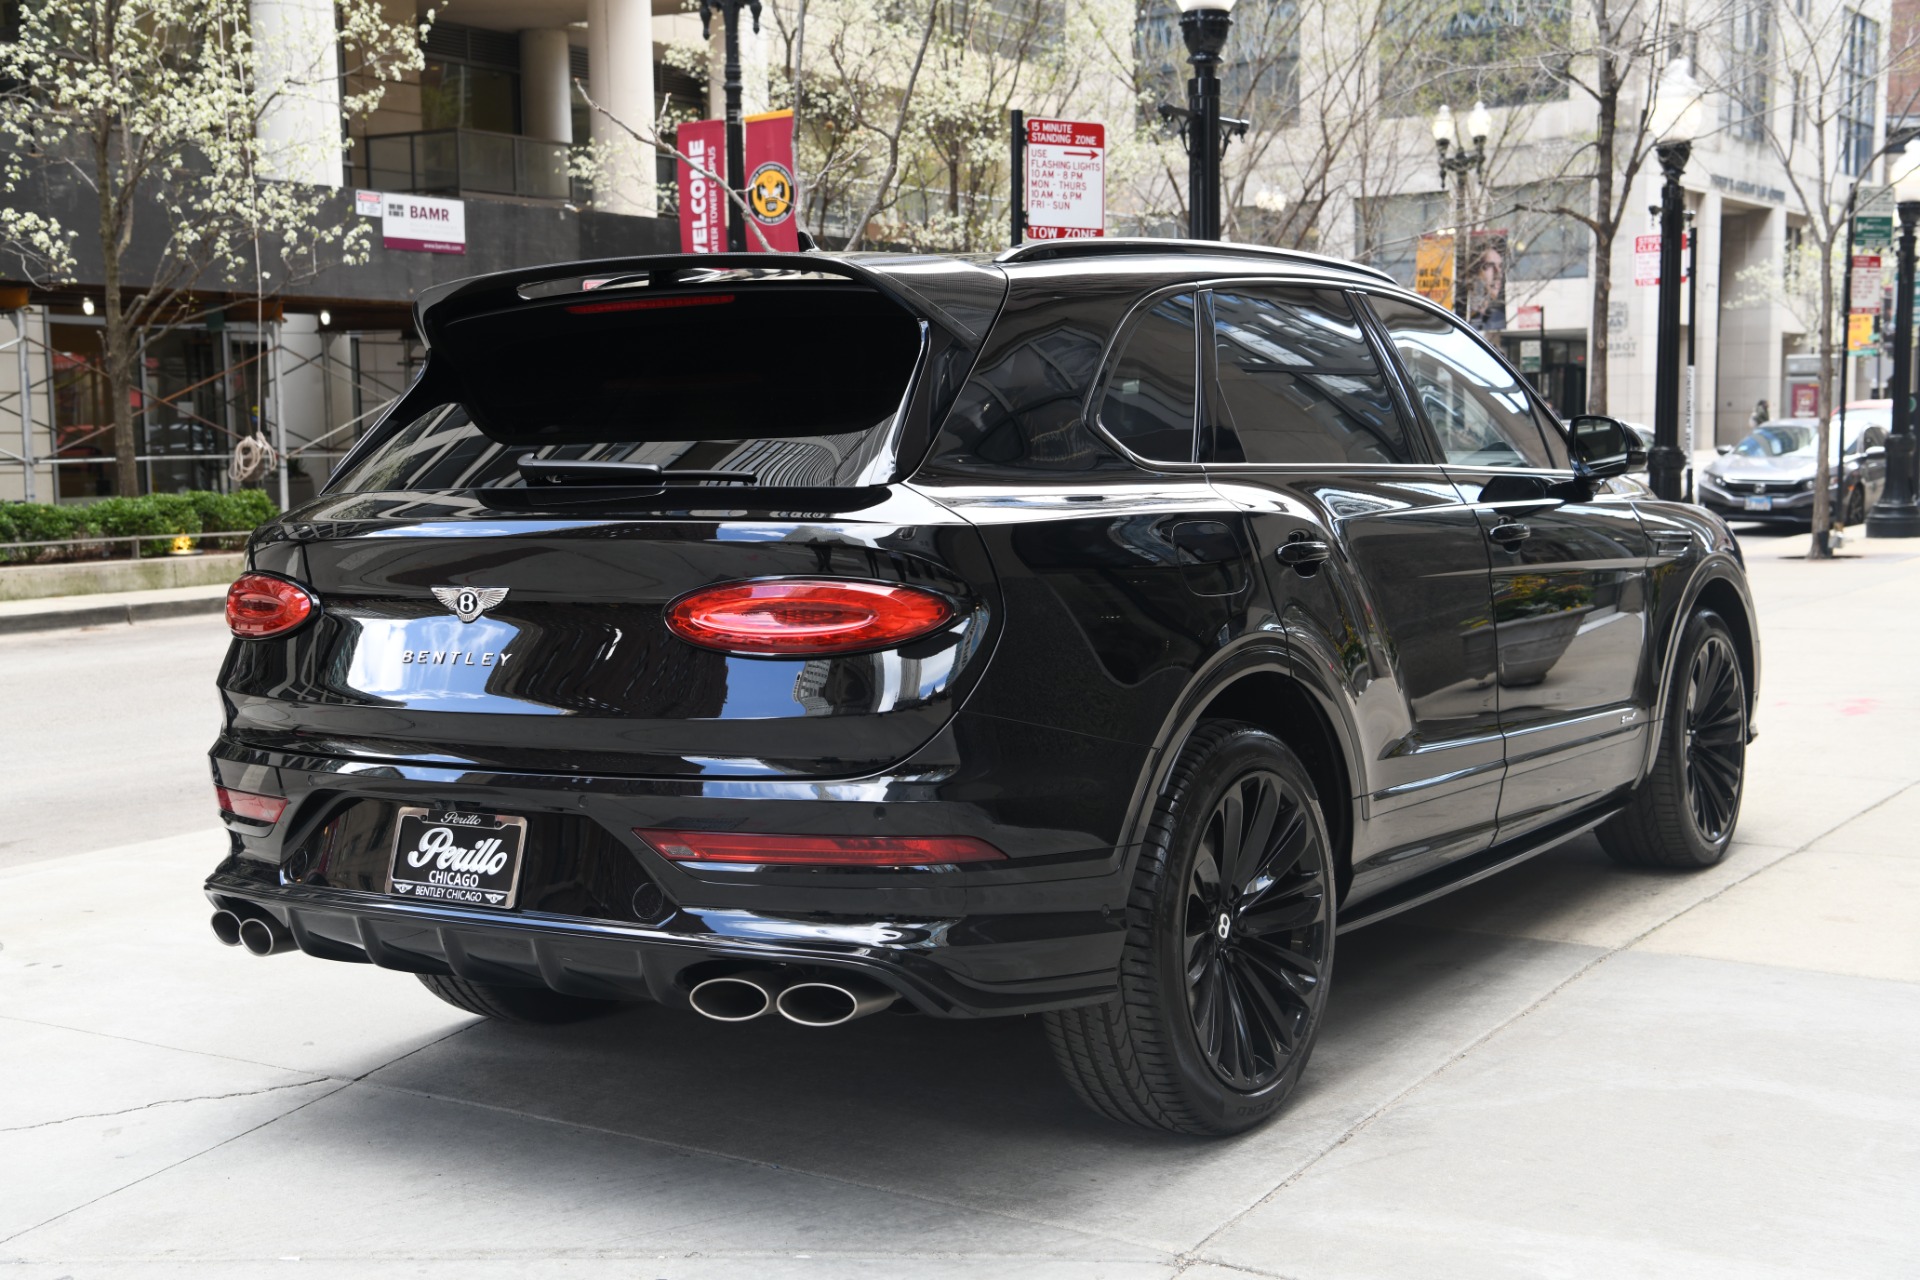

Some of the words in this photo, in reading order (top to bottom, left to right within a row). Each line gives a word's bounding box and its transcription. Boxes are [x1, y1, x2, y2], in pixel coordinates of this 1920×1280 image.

[1031, 122, 1040, 131] 15
[1042, 123, 1074, 134] MINUTE
[1031, 131, 1072, 144] STANDING
[1075, 135, 1098, 146] ZONE
[1031, 149, 1048, 158] USE
[1031, 159, 1071, 170] FLASHING
[1072, 162, 1101, 172] LIGHTS
[1031, 169, 1041, 178] 10
[1041, 170, 1055, 179] AM
[1062, 171, 1068, 181] 8
[1070, 171, 1083, 180] PM
[1031, 180, 1050, 189] MON
[1059, 181, 1088, 191] THURS
[1031, 190, 1040, 199] 10
[1041, 191, 1054, 200] AM
[1062, 191, 1068, 200] 6
[1070, 192, 1082, 201] PM
[708, 189, 718, 226] TOWER
[1031, 200, 1045, 209] FRI
[1052, 201, 1070, 210] SUN
[410, 205, 449, 222] BAMR
[1031, 226, 1058, 239] TOW
[1065, 228, 1098, 238] ZONE
[402, 650, 513, 667] BENTLEY
[440, 811, 482, 826] Perillo
[407, 827, 508, 876] Perillo
[428, 870, 480, 888] CHICAGO
[415, 885, 447, 899] BENTLEY
[446, 888, 483, 903] CHICAGO
